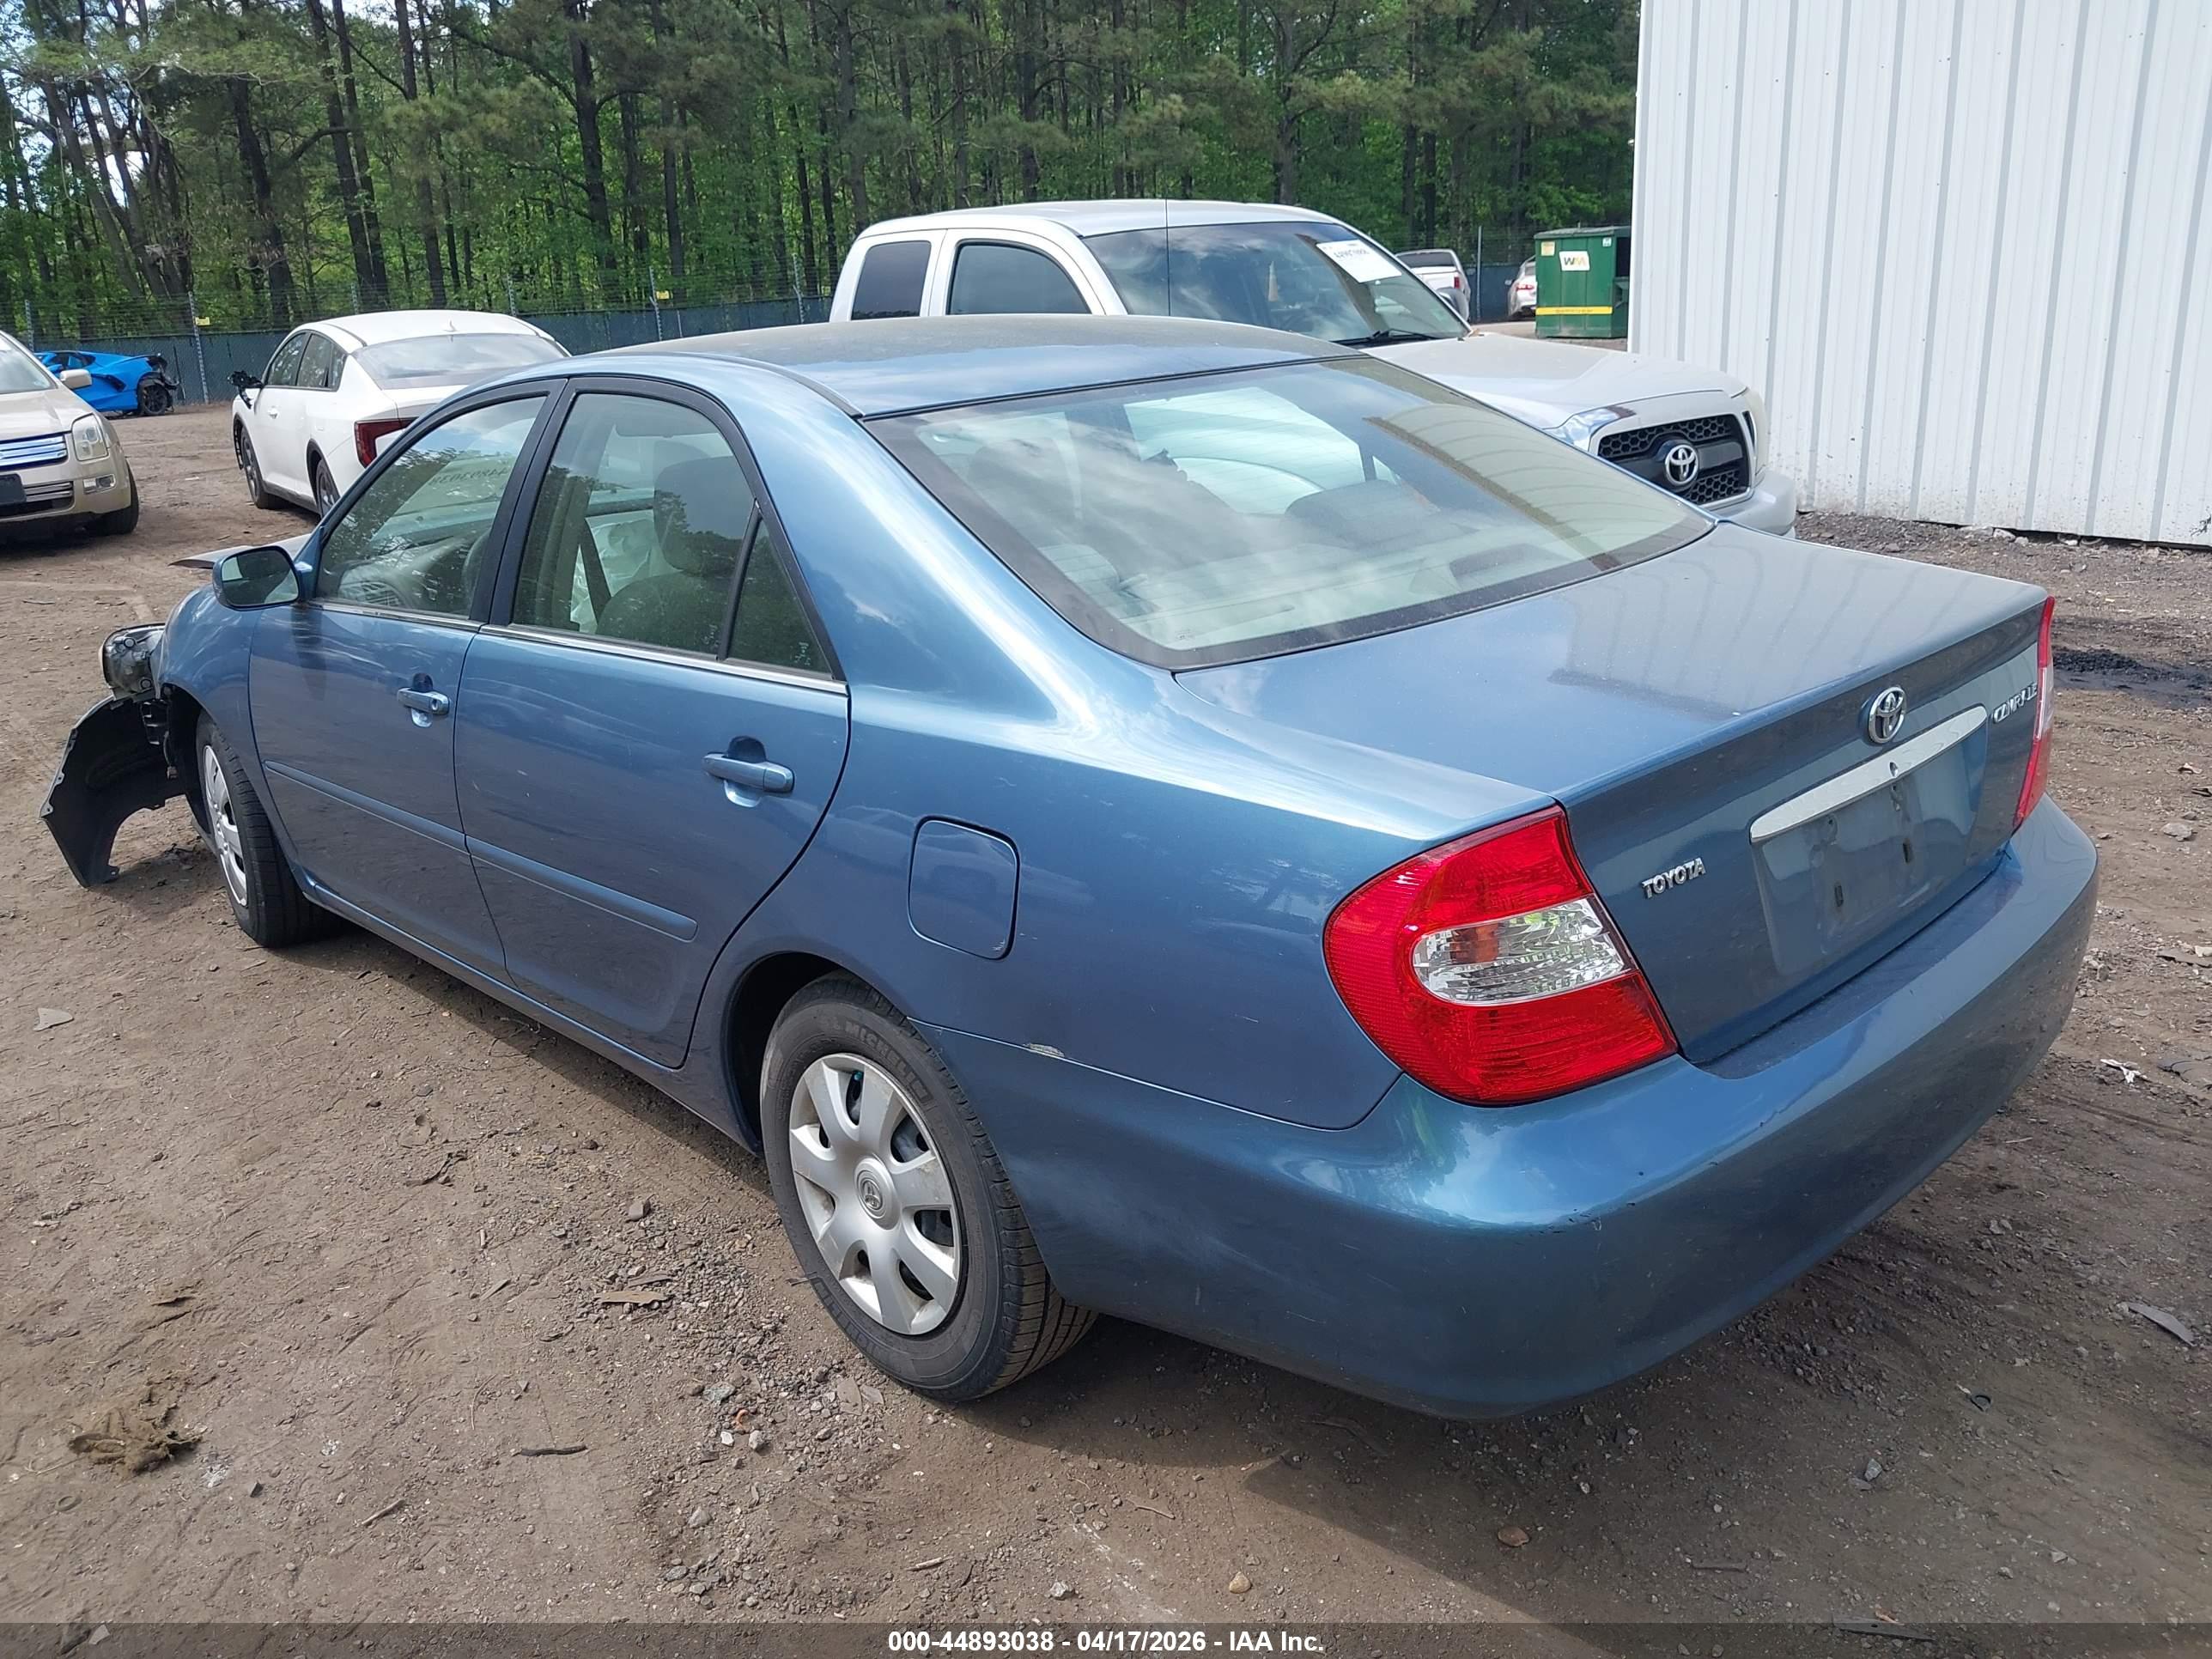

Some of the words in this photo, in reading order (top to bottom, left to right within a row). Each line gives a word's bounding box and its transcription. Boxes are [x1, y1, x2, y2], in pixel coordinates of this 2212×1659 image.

[1564, 257, 1587, 265] WM
[1641, 857, 1706, 899] TOYOTA
[845, 1019, 931, 1103] MICHELIN
